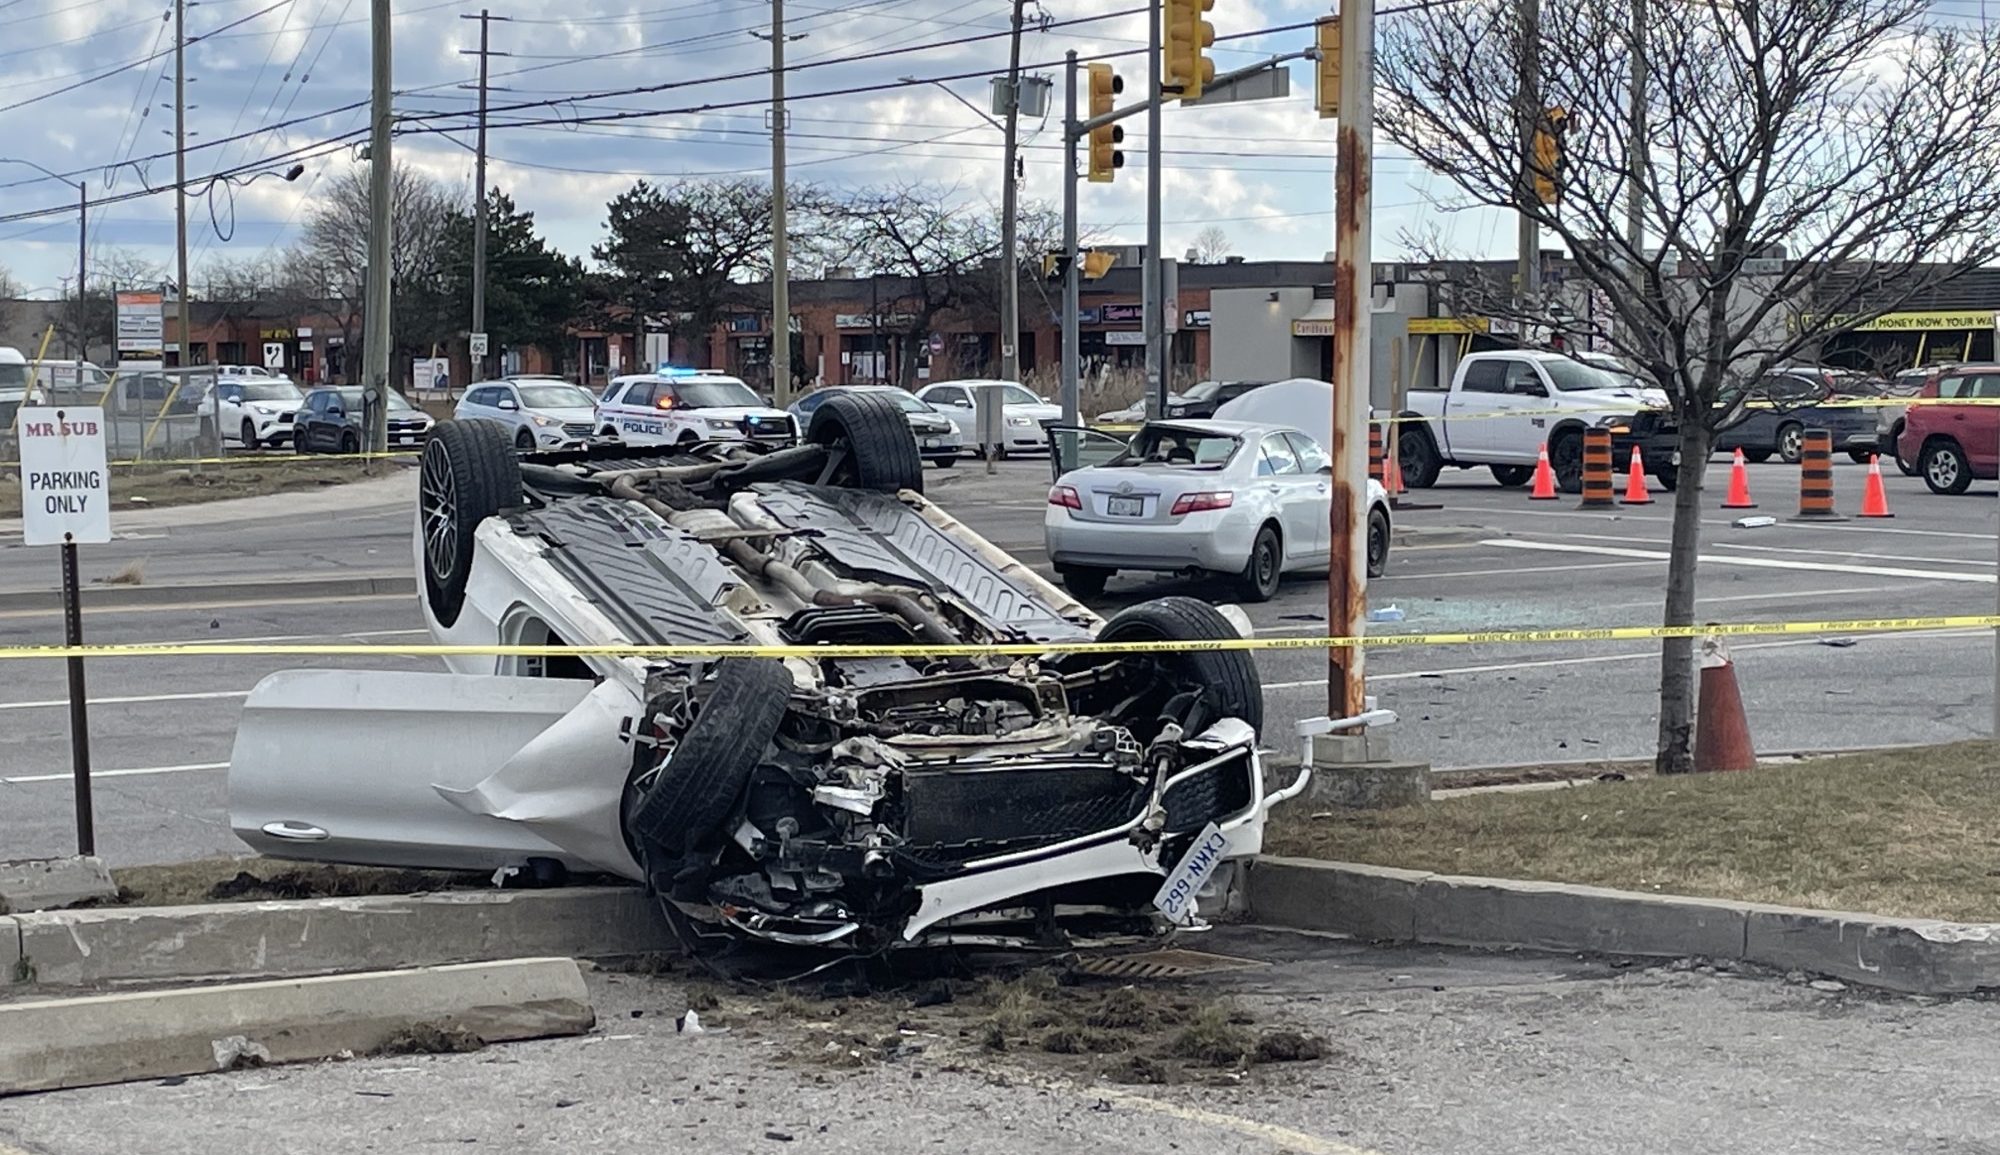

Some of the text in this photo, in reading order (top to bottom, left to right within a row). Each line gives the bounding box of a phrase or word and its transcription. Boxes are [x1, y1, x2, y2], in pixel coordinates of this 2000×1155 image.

[1878, 317, 1914, 328] MONEY
[1945, 316, 1973, 327] YOUR
[472, 342, 485, 352] 60
[623, 422, 664, 435] POLICE
[30, 471, 100, 491] PARKING
[45, 495, 88, 514] ONLY
